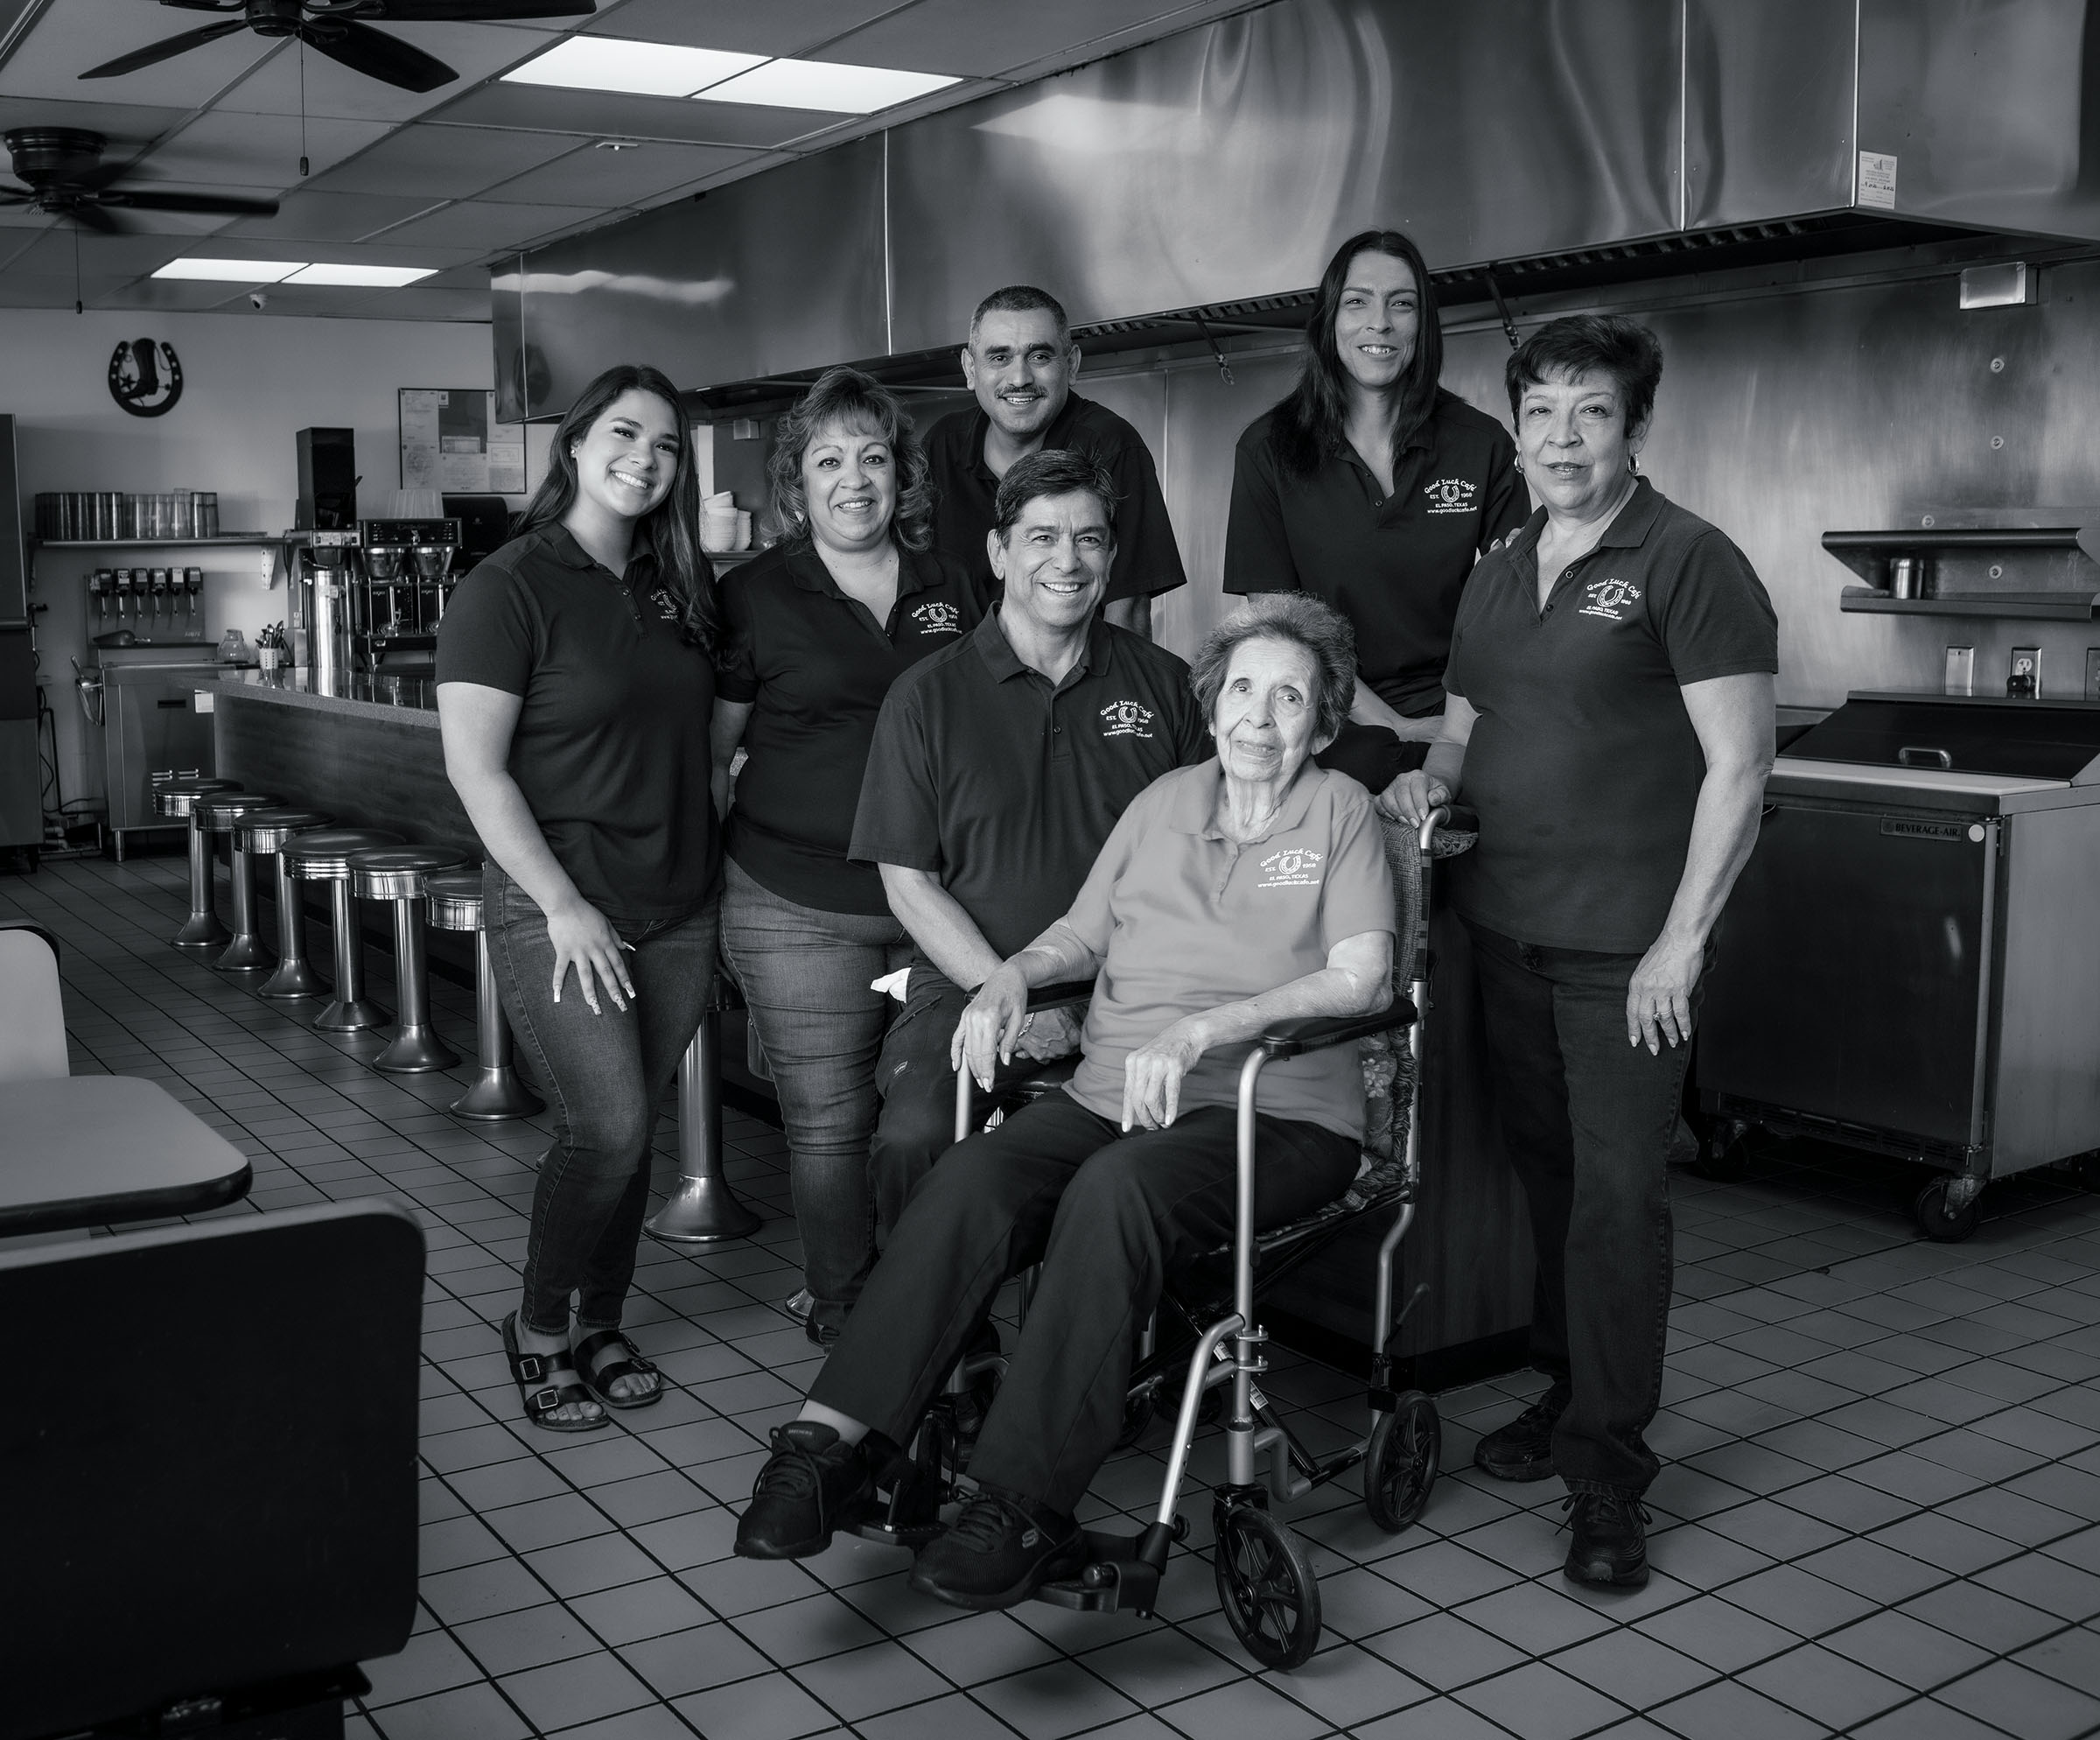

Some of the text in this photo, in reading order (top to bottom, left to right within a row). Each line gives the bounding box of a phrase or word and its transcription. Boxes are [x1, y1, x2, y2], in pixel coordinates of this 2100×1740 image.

[1424, 480, 1440, 494] Good
[1586, 579, 1608, 591] Good
[1608, 579, 1628, 588] Luck
[912, 605, 927, 618] Good
[1100, 701, 1119, 716] Good
[1260, 852, 1281, 867] Good
[1305, 850, 1324, 862] Café
